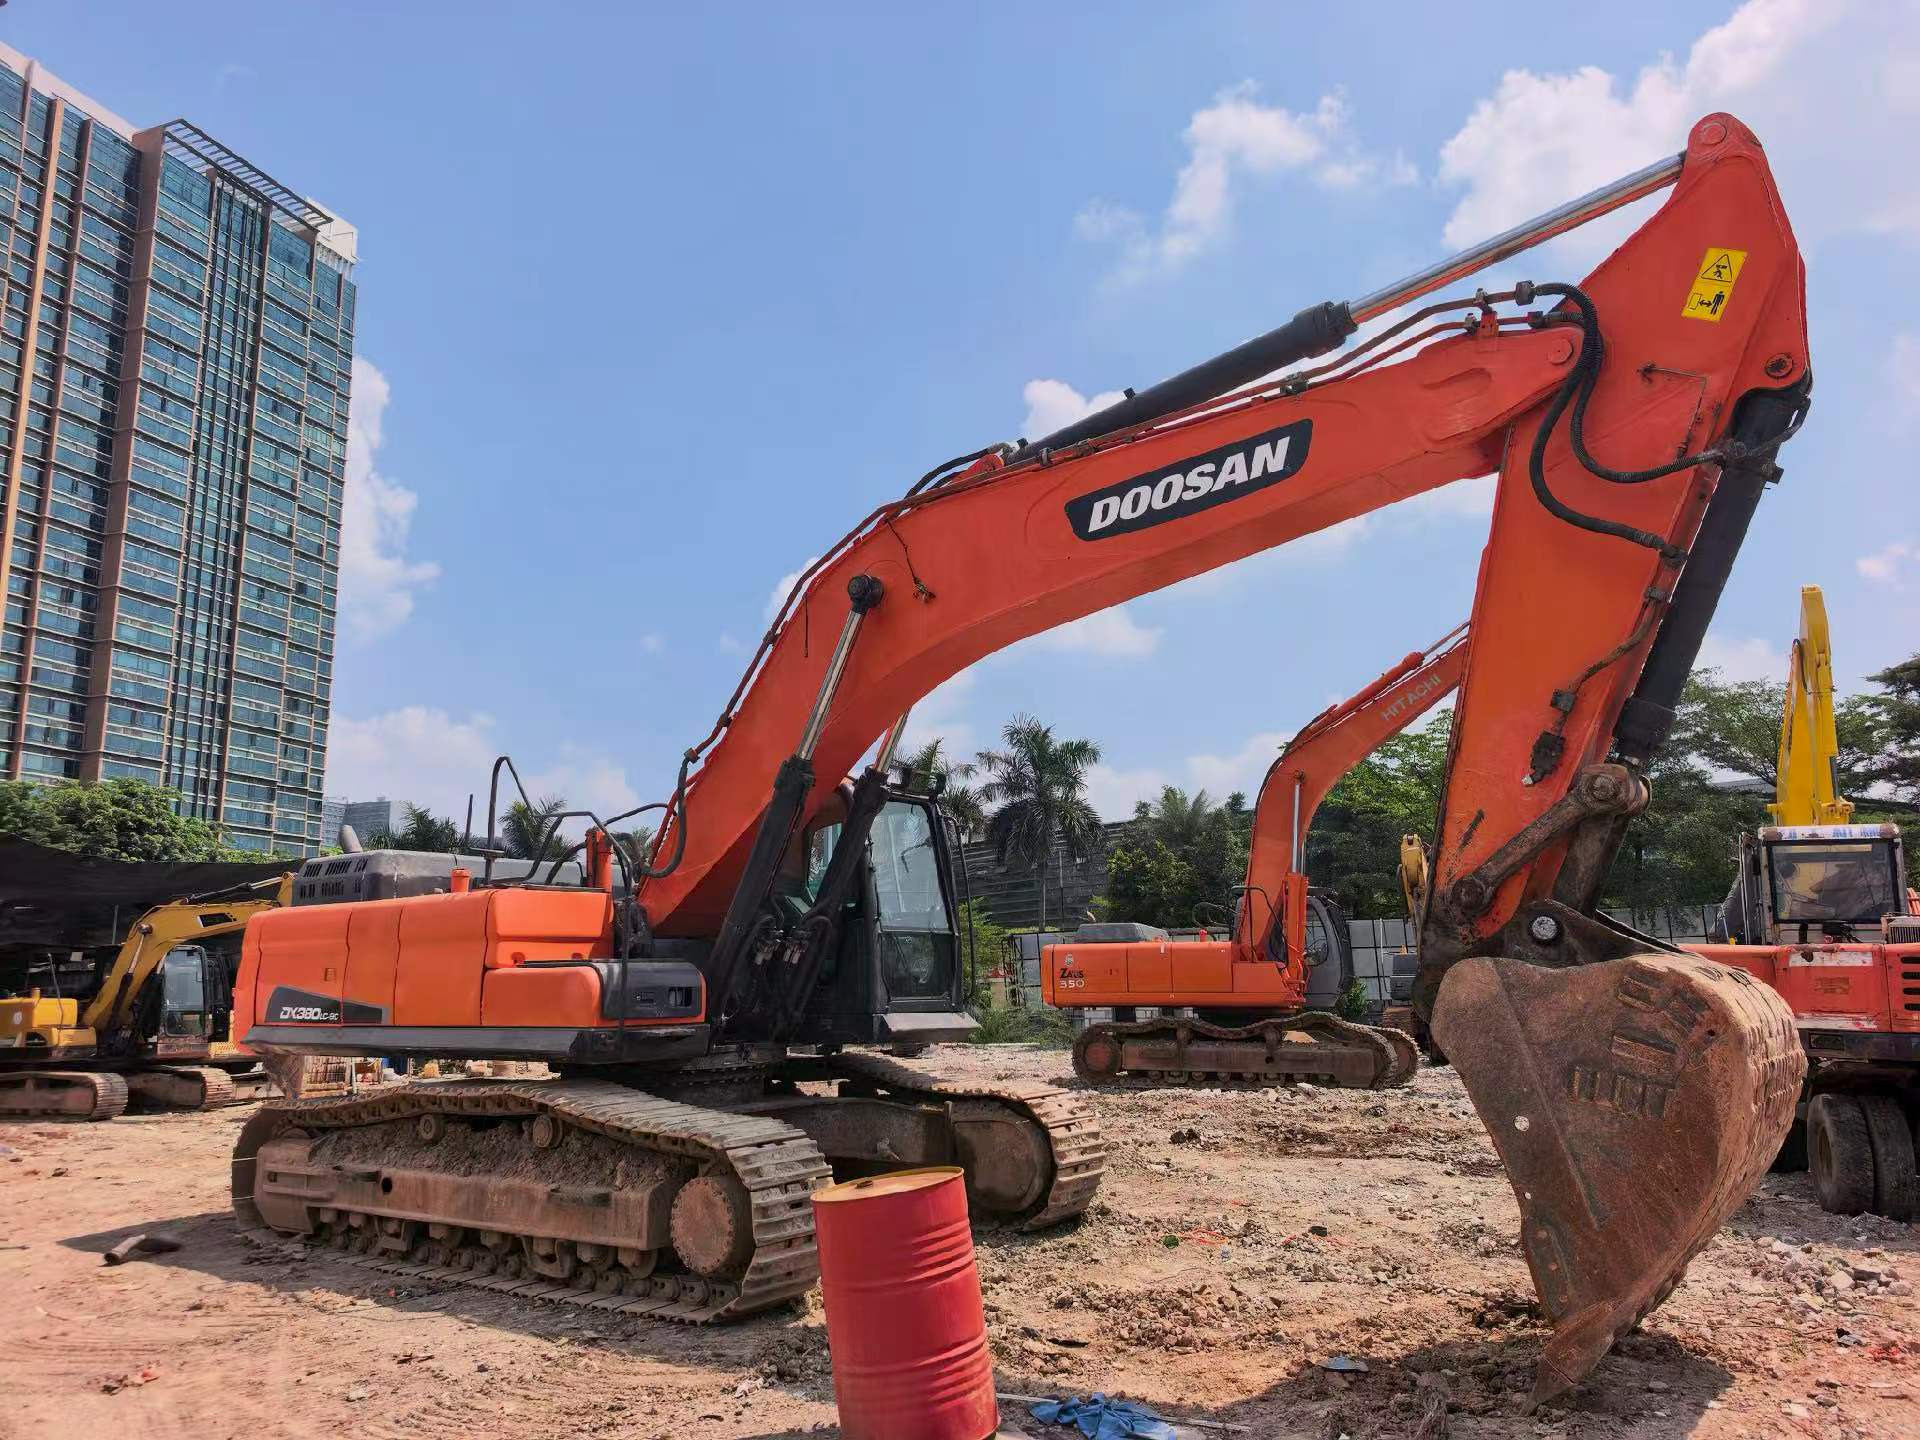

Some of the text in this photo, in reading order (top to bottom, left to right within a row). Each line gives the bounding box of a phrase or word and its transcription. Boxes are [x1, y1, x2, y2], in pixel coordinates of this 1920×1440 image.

[1087, 436, 1291, 533] DOOSAN
[1382, 674, 1442, 721] HITACHI
[1059, 979, 1085, 989] 350
